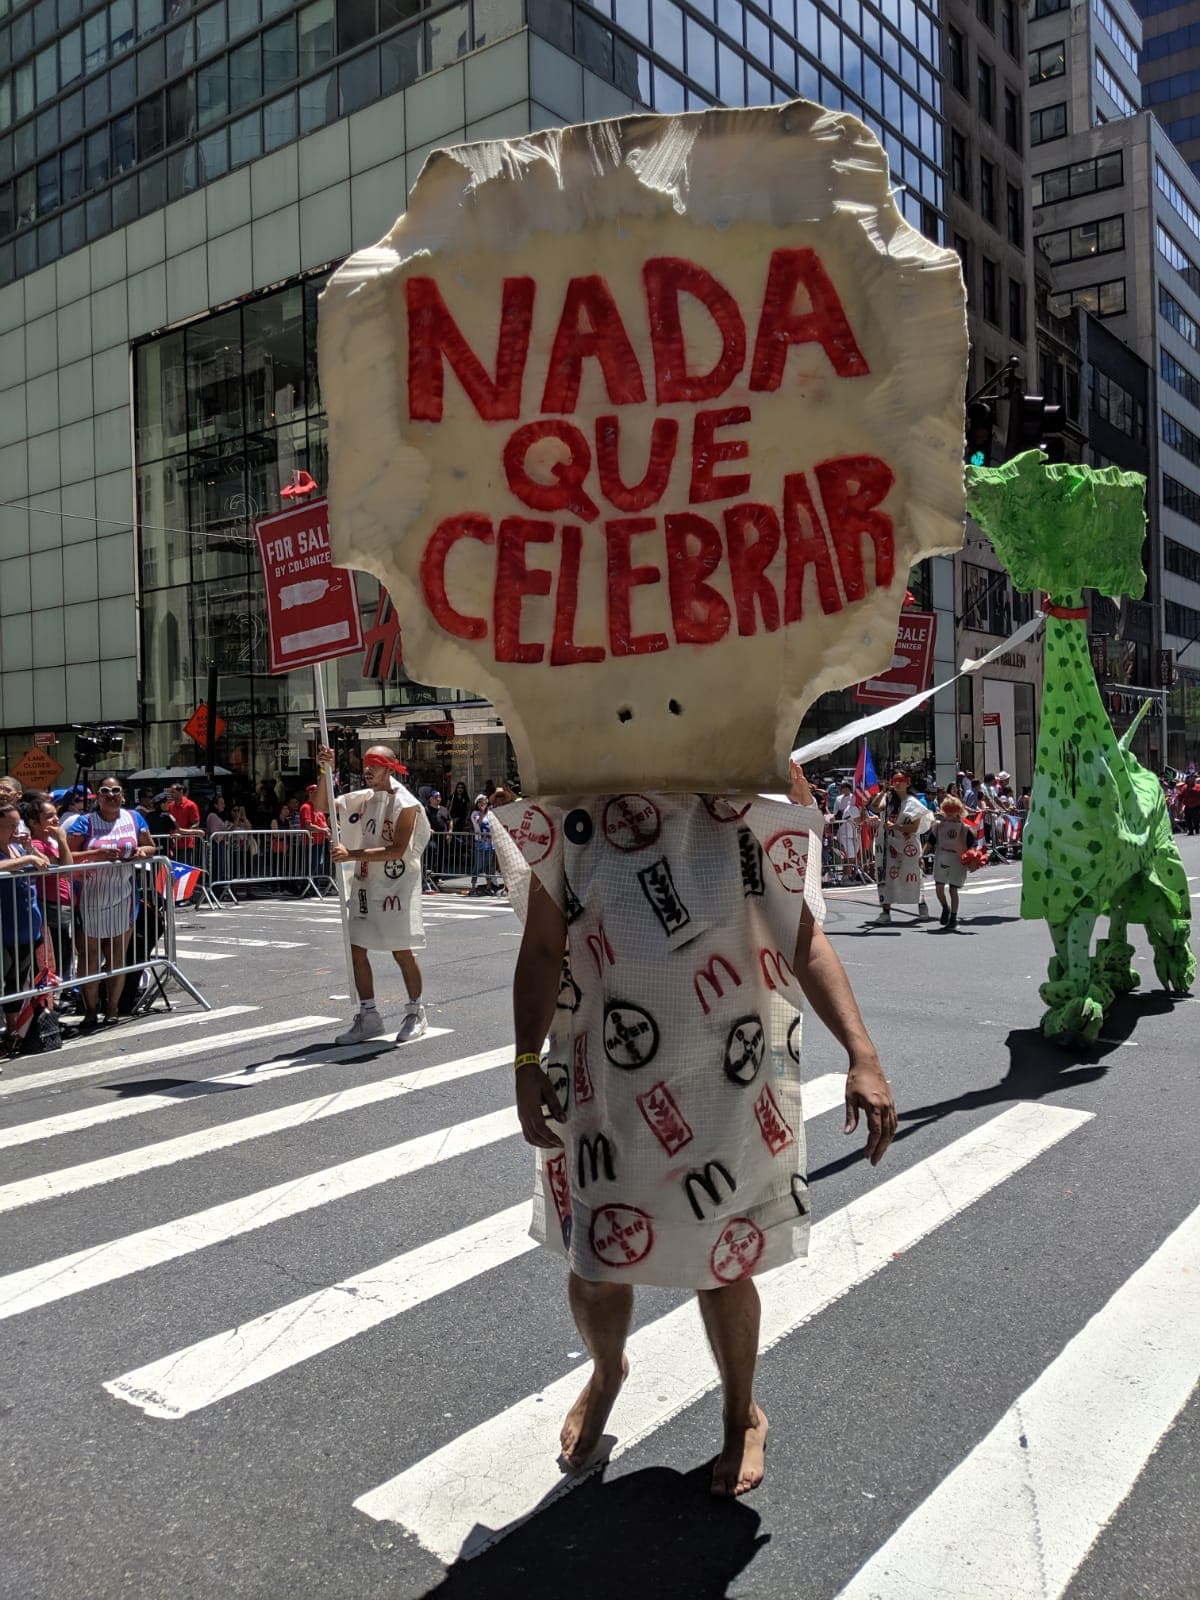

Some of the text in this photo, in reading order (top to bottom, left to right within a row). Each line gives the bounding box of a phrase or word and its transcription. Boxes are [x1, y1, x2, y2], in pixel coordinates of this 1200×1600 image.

[405, 247, 870, 423] NADA
[503, 406, 752, 523] QUE
[267, 525, 331, 564] FOR SAL
[275, 566, 287, 578] BY
[420, 455, 896, 667] CELEBRAR
